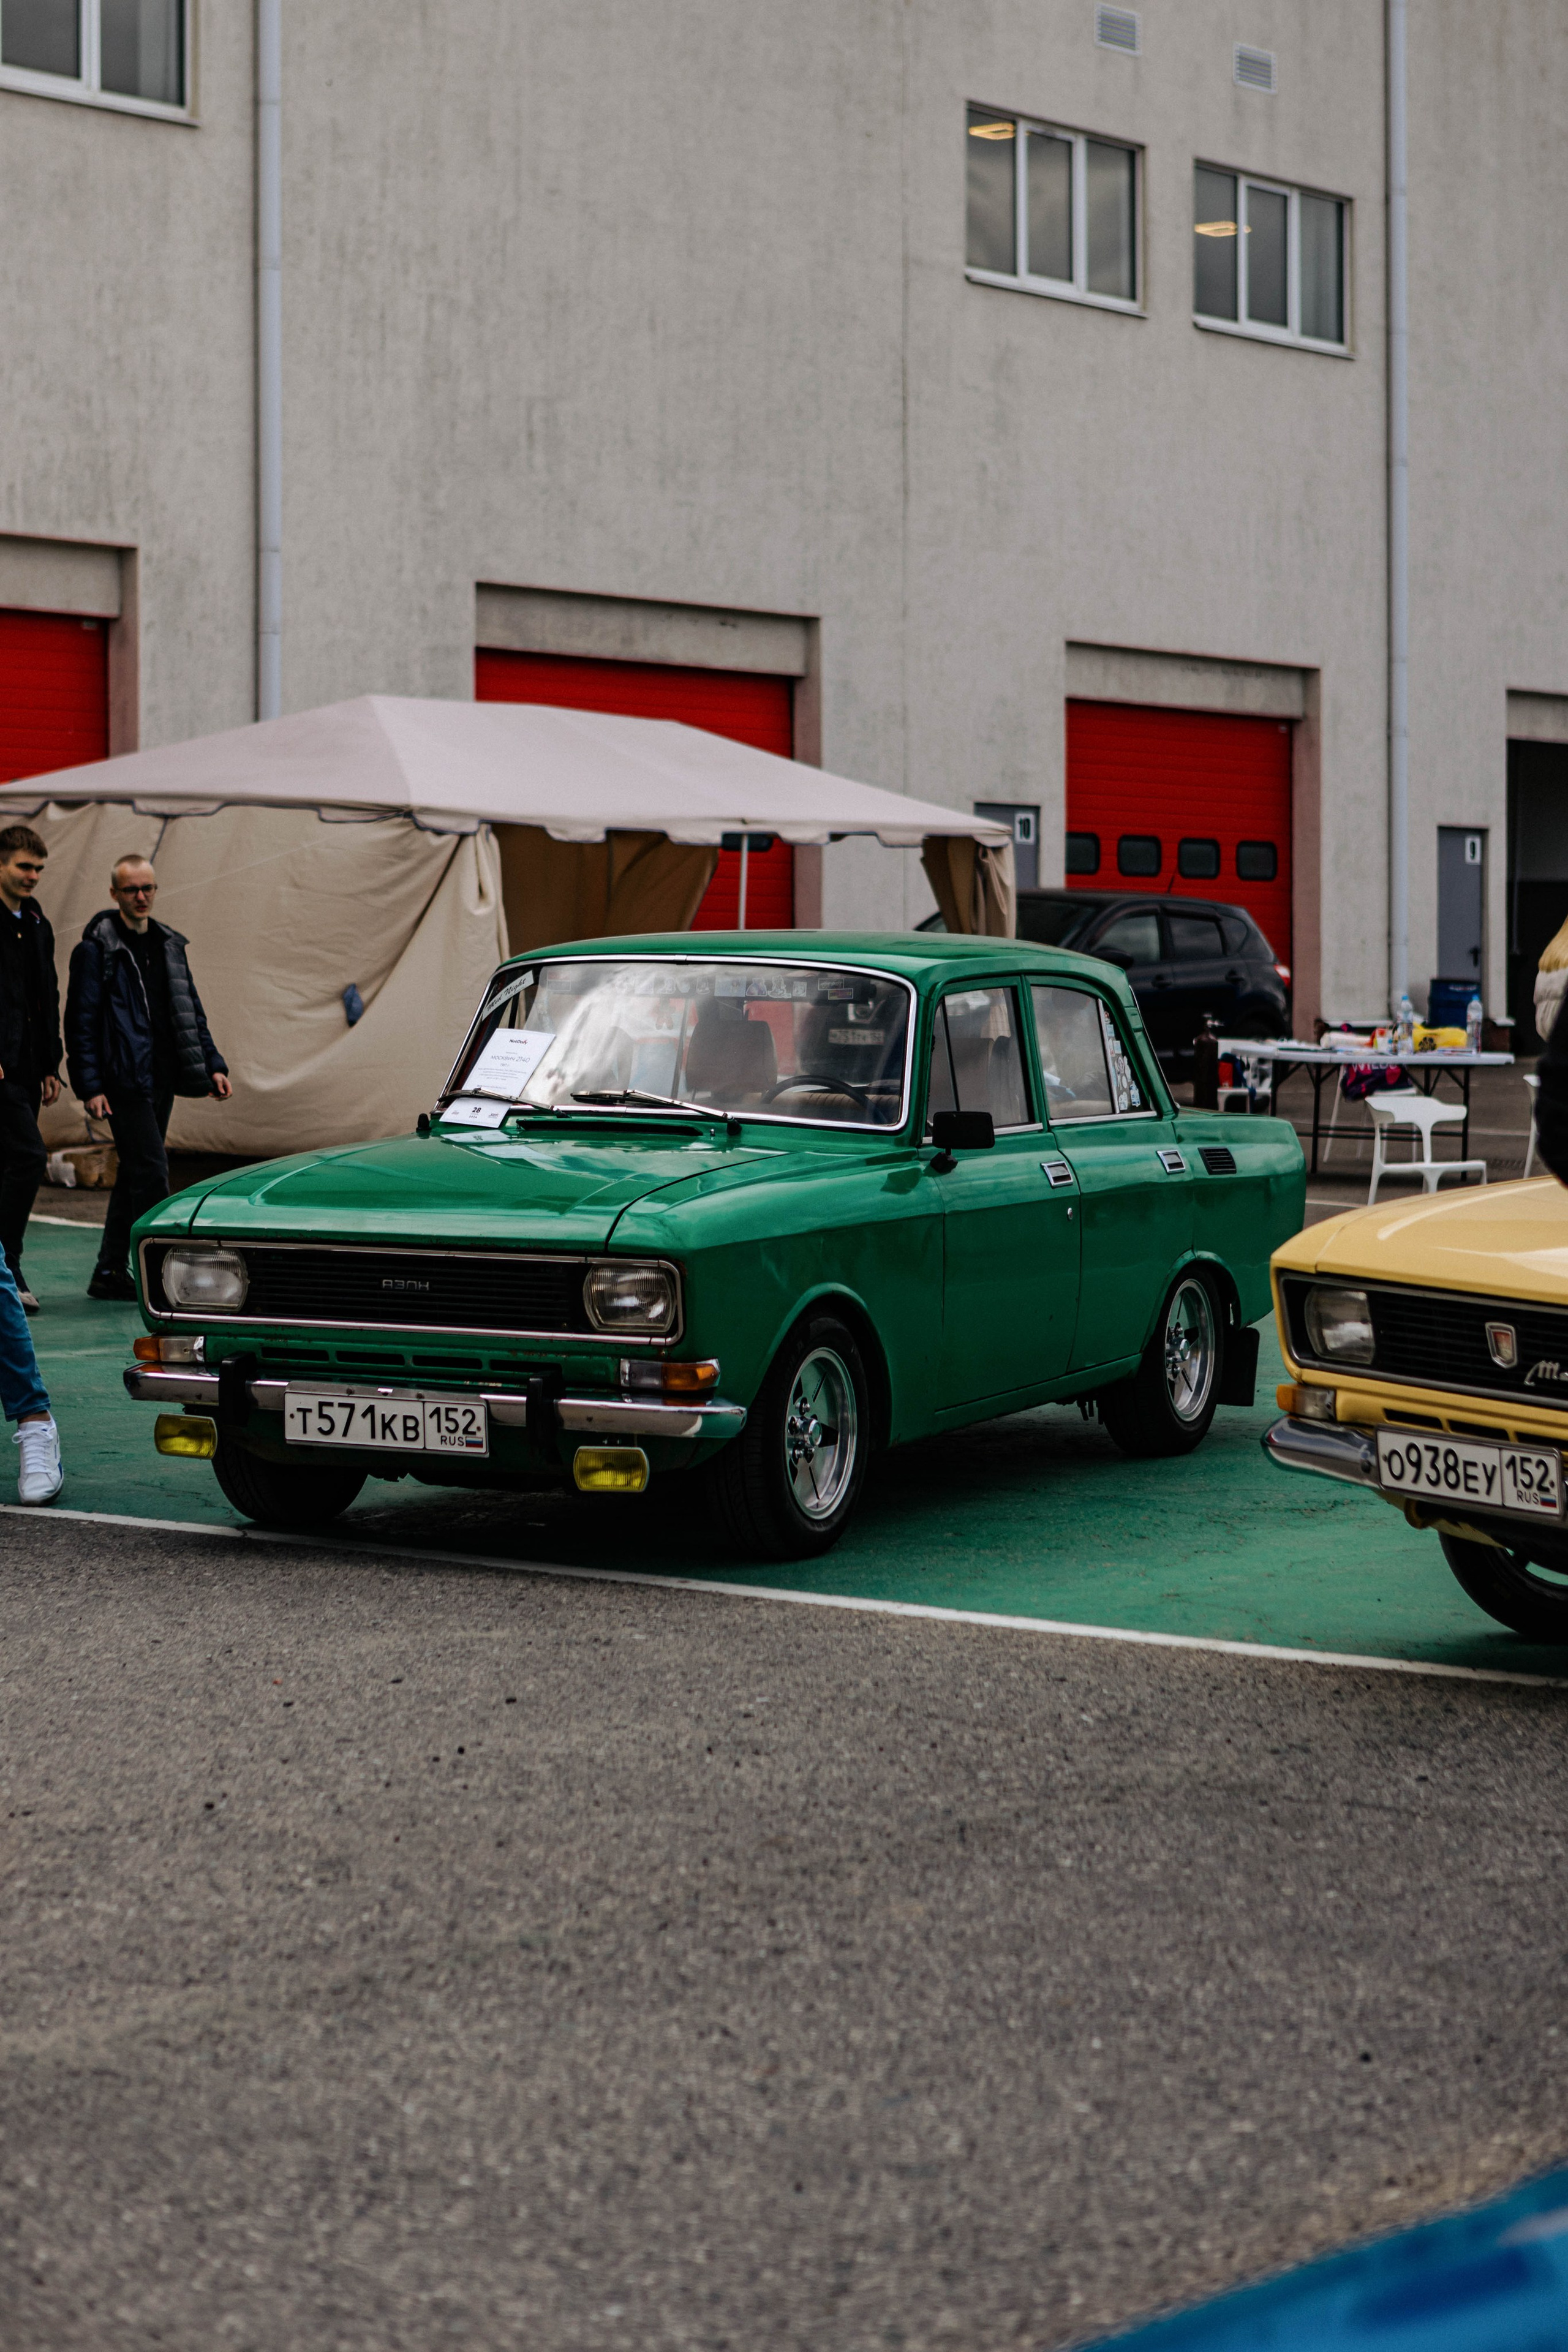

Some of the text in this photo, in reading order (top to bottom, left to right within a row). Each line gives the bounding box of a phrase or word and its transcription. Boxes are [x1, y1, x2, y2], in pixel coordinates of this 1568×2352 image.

[1018, 818, 1031, 839] 10
[503, 978, 526, 996] Night
[428, 1406, 477, 1435] 152
[440, 1435, 464, 1447] RUS
[1505, 1454, 1551, 1493] 152
[1517, 1490, 1539, 1504] RUS
